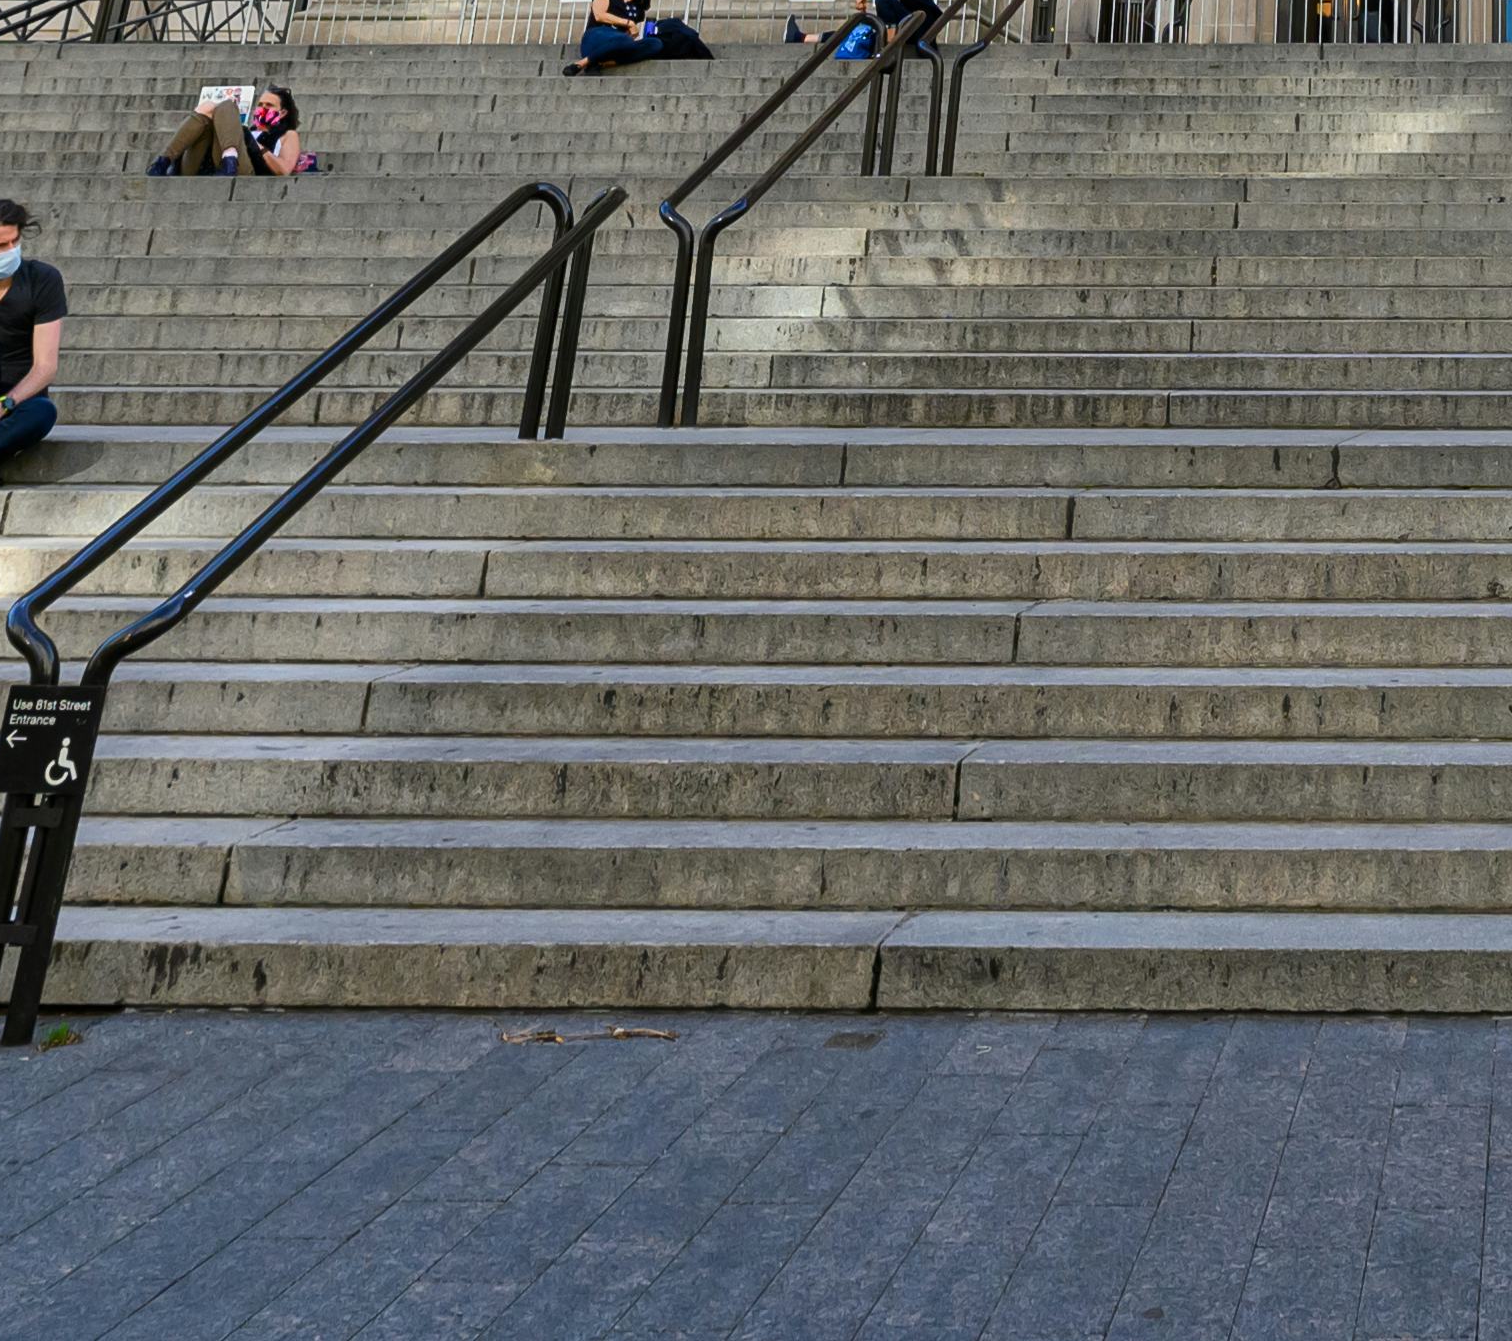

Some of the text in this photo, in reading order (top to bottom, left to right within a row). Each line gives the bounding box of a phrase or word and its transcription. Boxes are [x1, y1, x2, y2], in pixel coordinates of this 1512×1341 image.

[12, 699, 91, 711] Use 81st Street
[9, 713, 56, 725] Entrance
